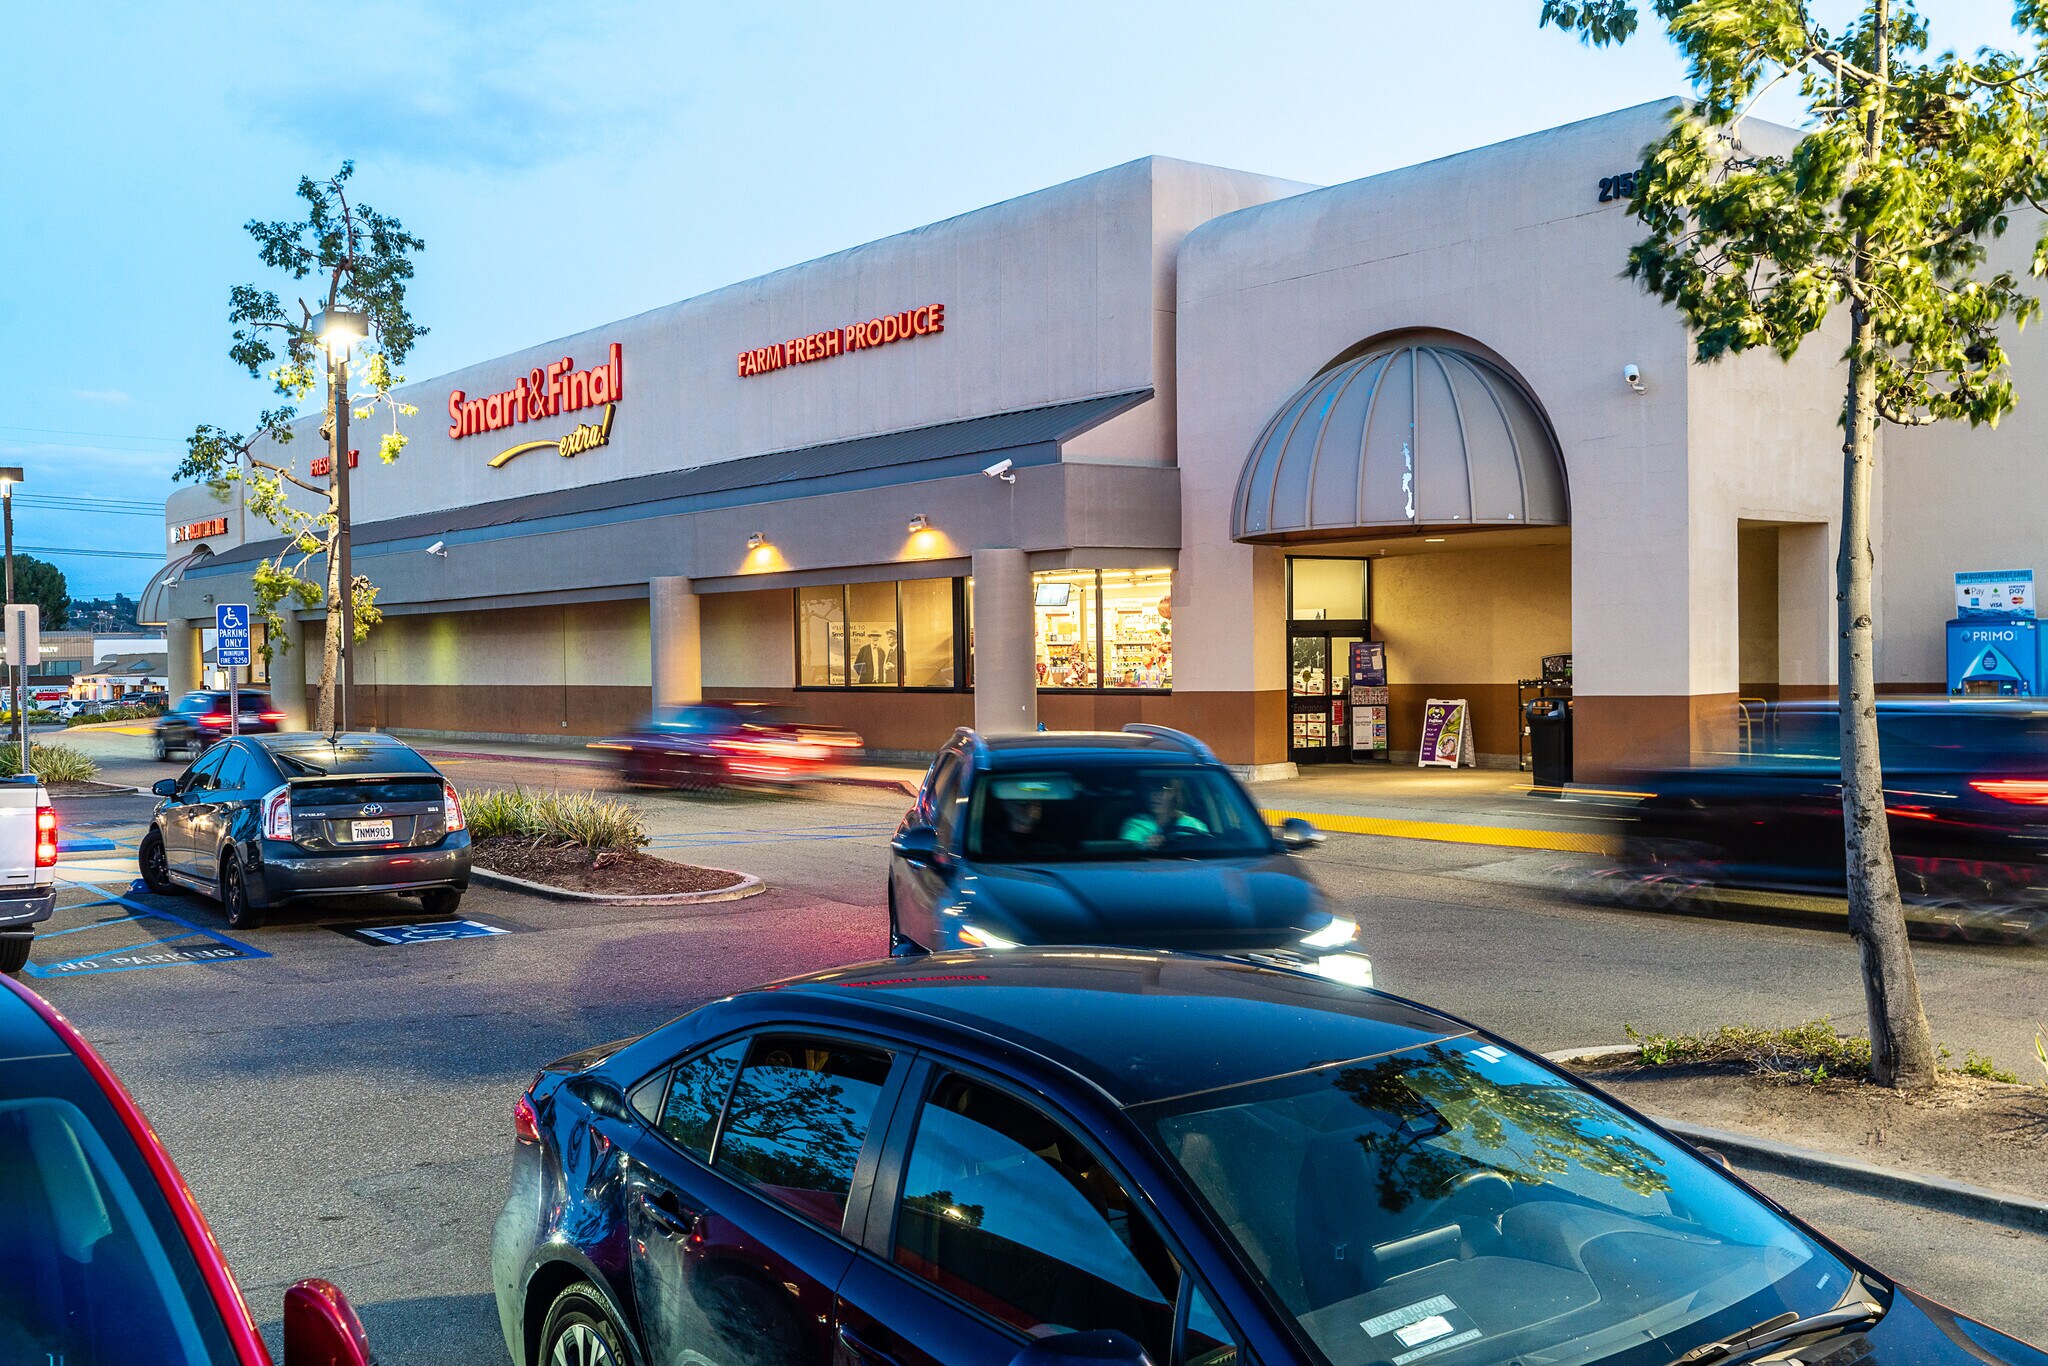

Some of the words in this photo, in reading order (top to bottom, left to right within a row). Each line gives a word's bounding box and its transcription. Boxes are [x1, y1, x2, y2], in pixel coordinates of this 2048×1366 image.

[737, 343, 787, 378] FARM
[786, 328, 844, 366] FRESH
[845, 303, 945, 352] PRODUCE
[448, 342, 622, 439] Smart&Final
[557, 403, 617, 458] extra!
[2009, 588, 2025, 596] pay
[219, 628, 248, 638] PARKING
[1973, 630, 2014, 642] PRIMO
[224, 638, 243, 648] ONLY
[1294, 703, 1324, 712] Entrance
[354, 827, 391, 838] 7NMM903
[56, 960, 100, 972] NO
[111, 949, 236, 965] PARKING
[1364, 1309, 1406, 1331] MILLER
[1406, 1297, 1449, 1316] TOYOTA
